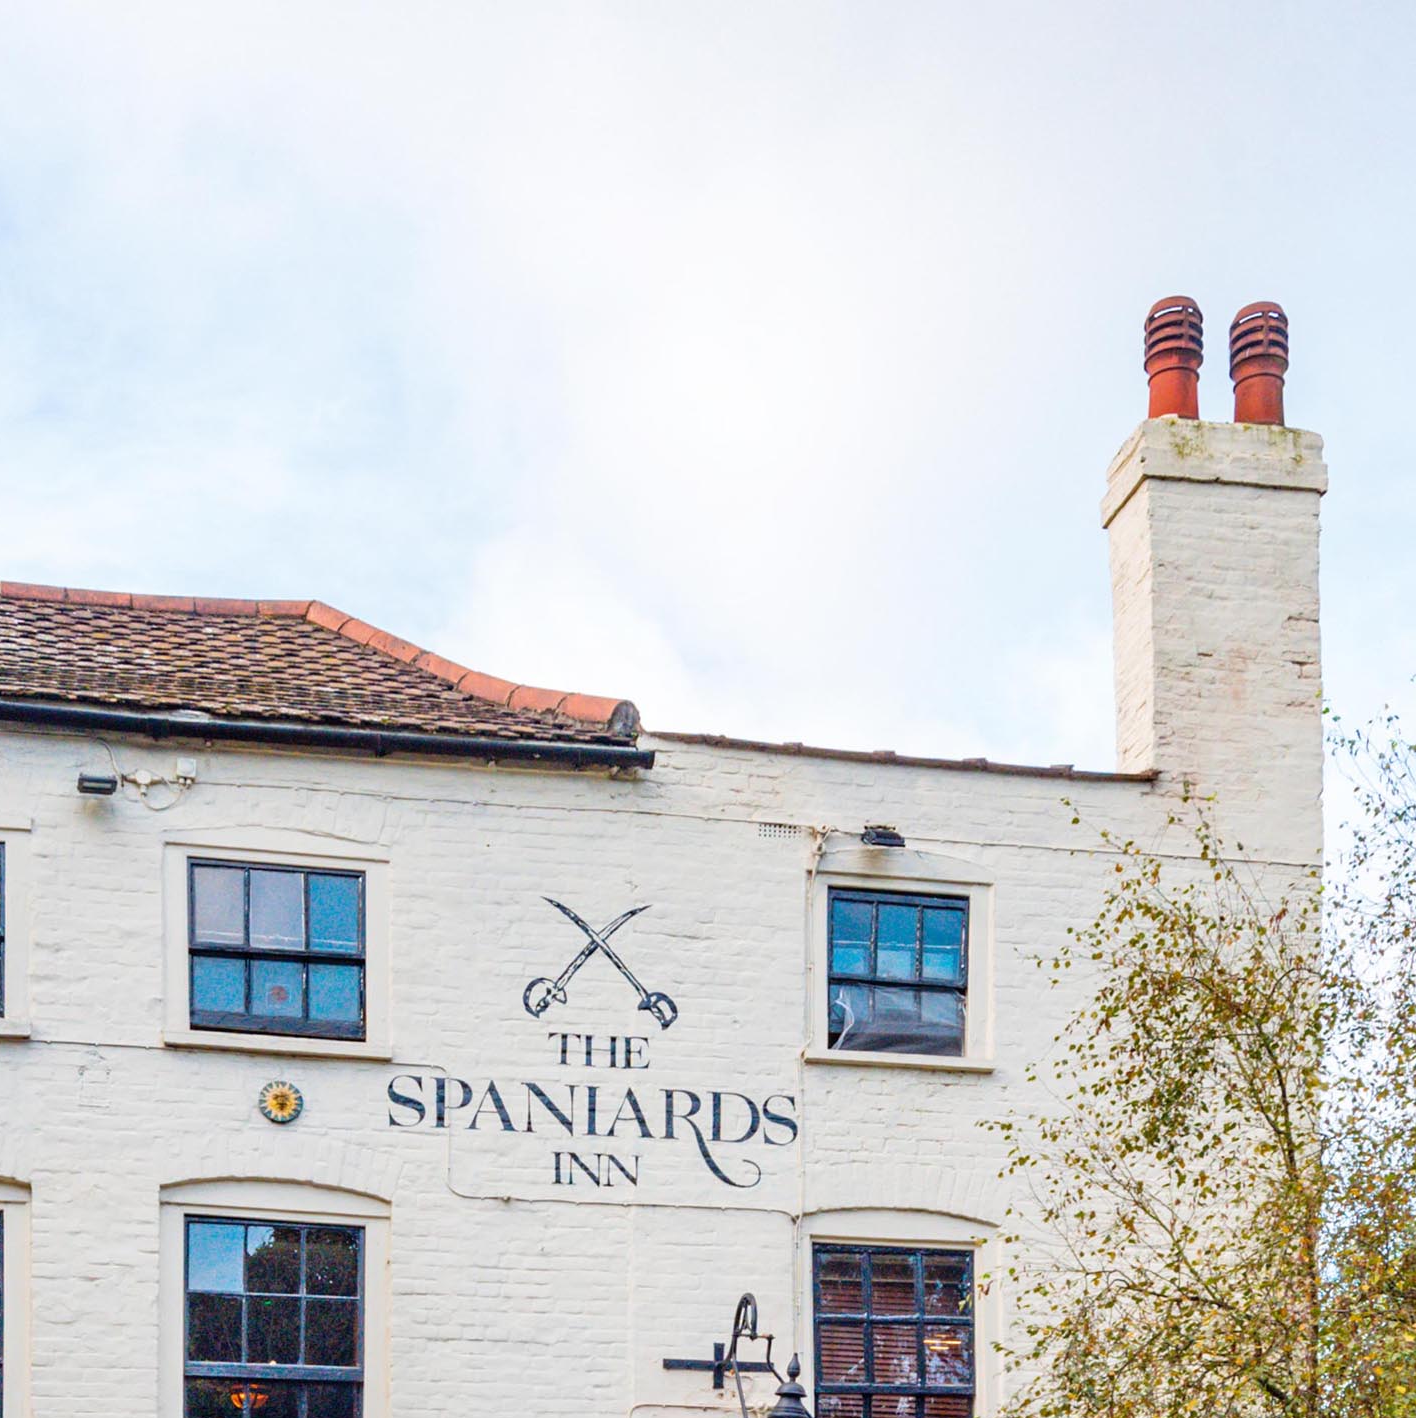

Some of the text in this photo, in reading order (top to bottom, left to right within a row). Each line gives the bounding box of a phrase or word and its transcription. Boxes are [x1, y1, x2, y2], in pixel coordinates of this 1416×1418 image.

[548, 1032, 650, 1070] THE
[387, 1075, 798, 1188] SPANIARDS
[551, 1151, 640, 1187] INN
